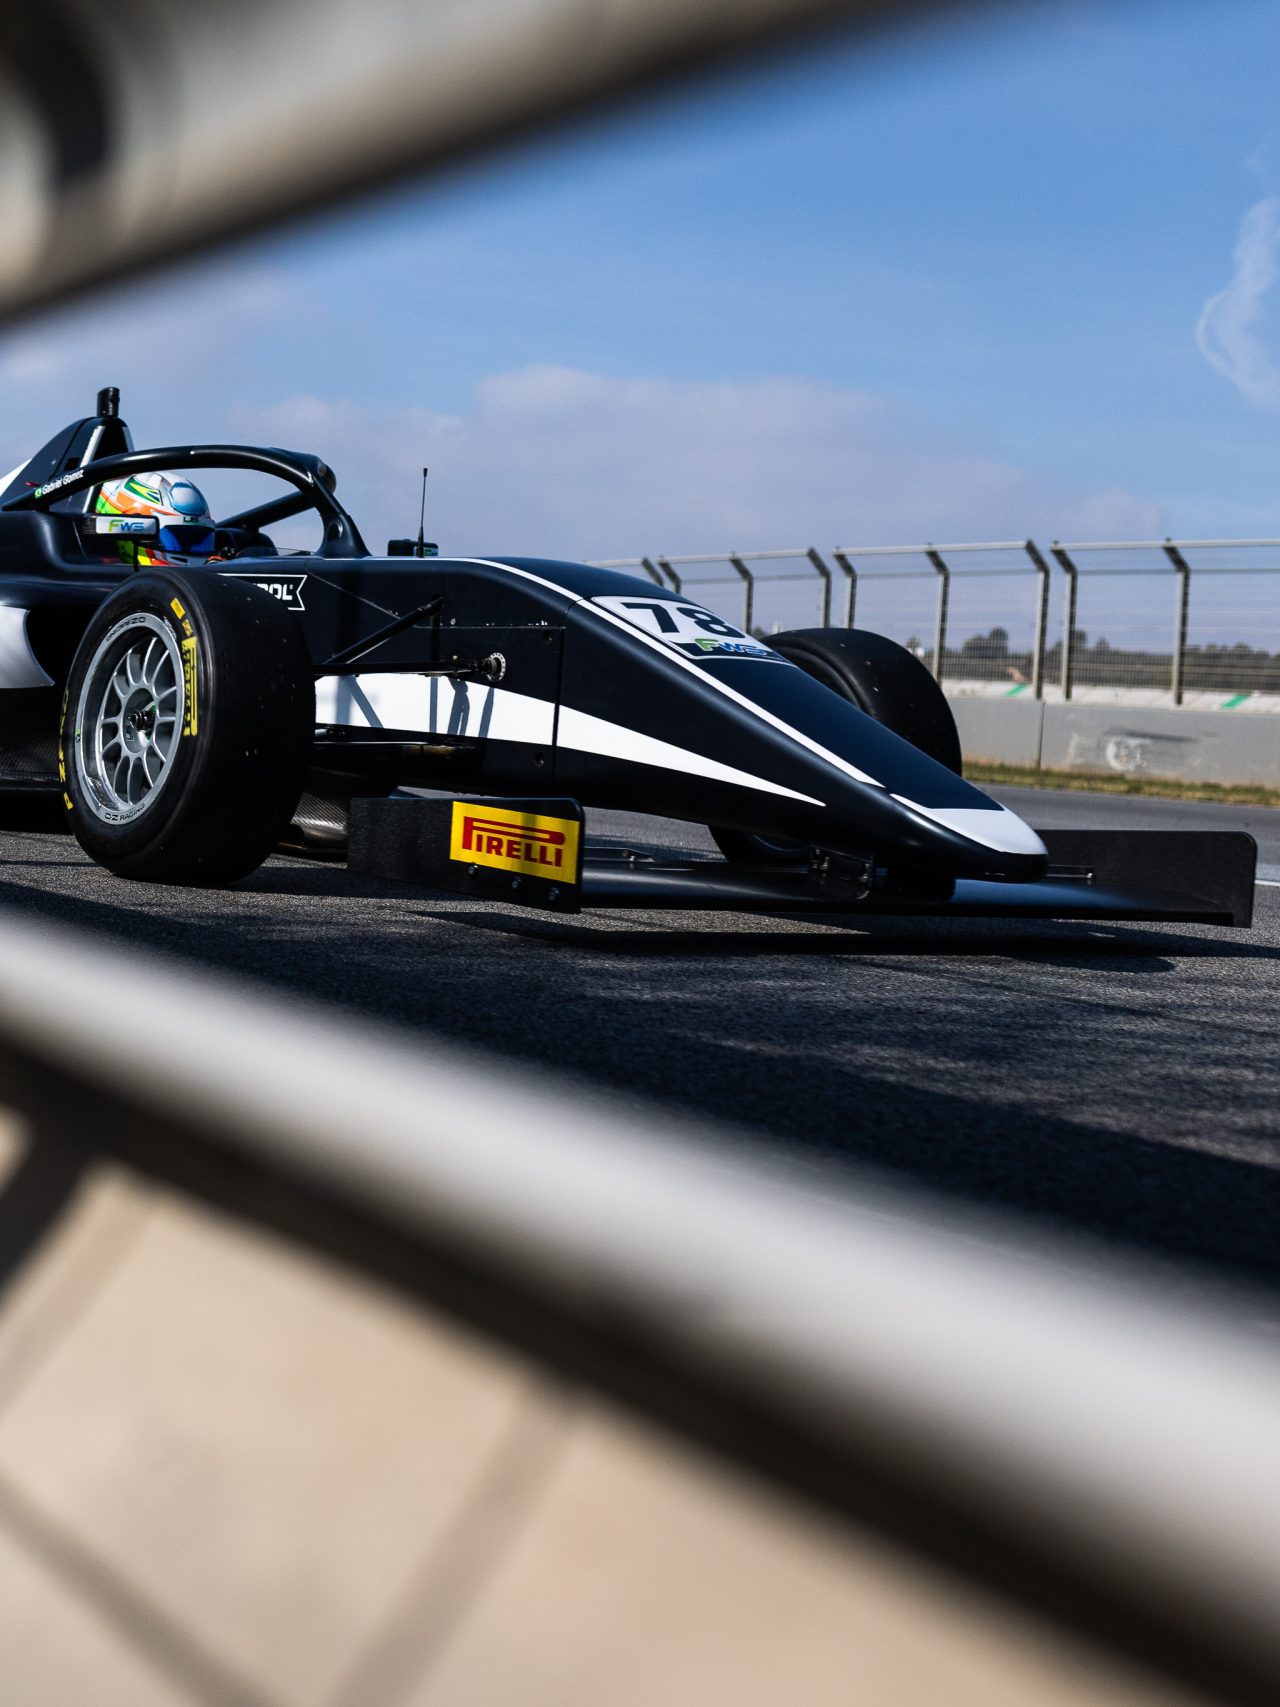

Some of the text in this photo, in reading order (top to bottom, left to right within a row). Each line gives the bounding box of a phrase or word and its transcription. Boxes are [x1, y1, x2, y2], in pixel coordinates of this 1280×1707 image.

[108, 519, 144, 532] FWS
[621, 602, 746, 639] 78
[694, 638, 768, 657] FWS
[462, 816, 567, 868] PIRELLI
